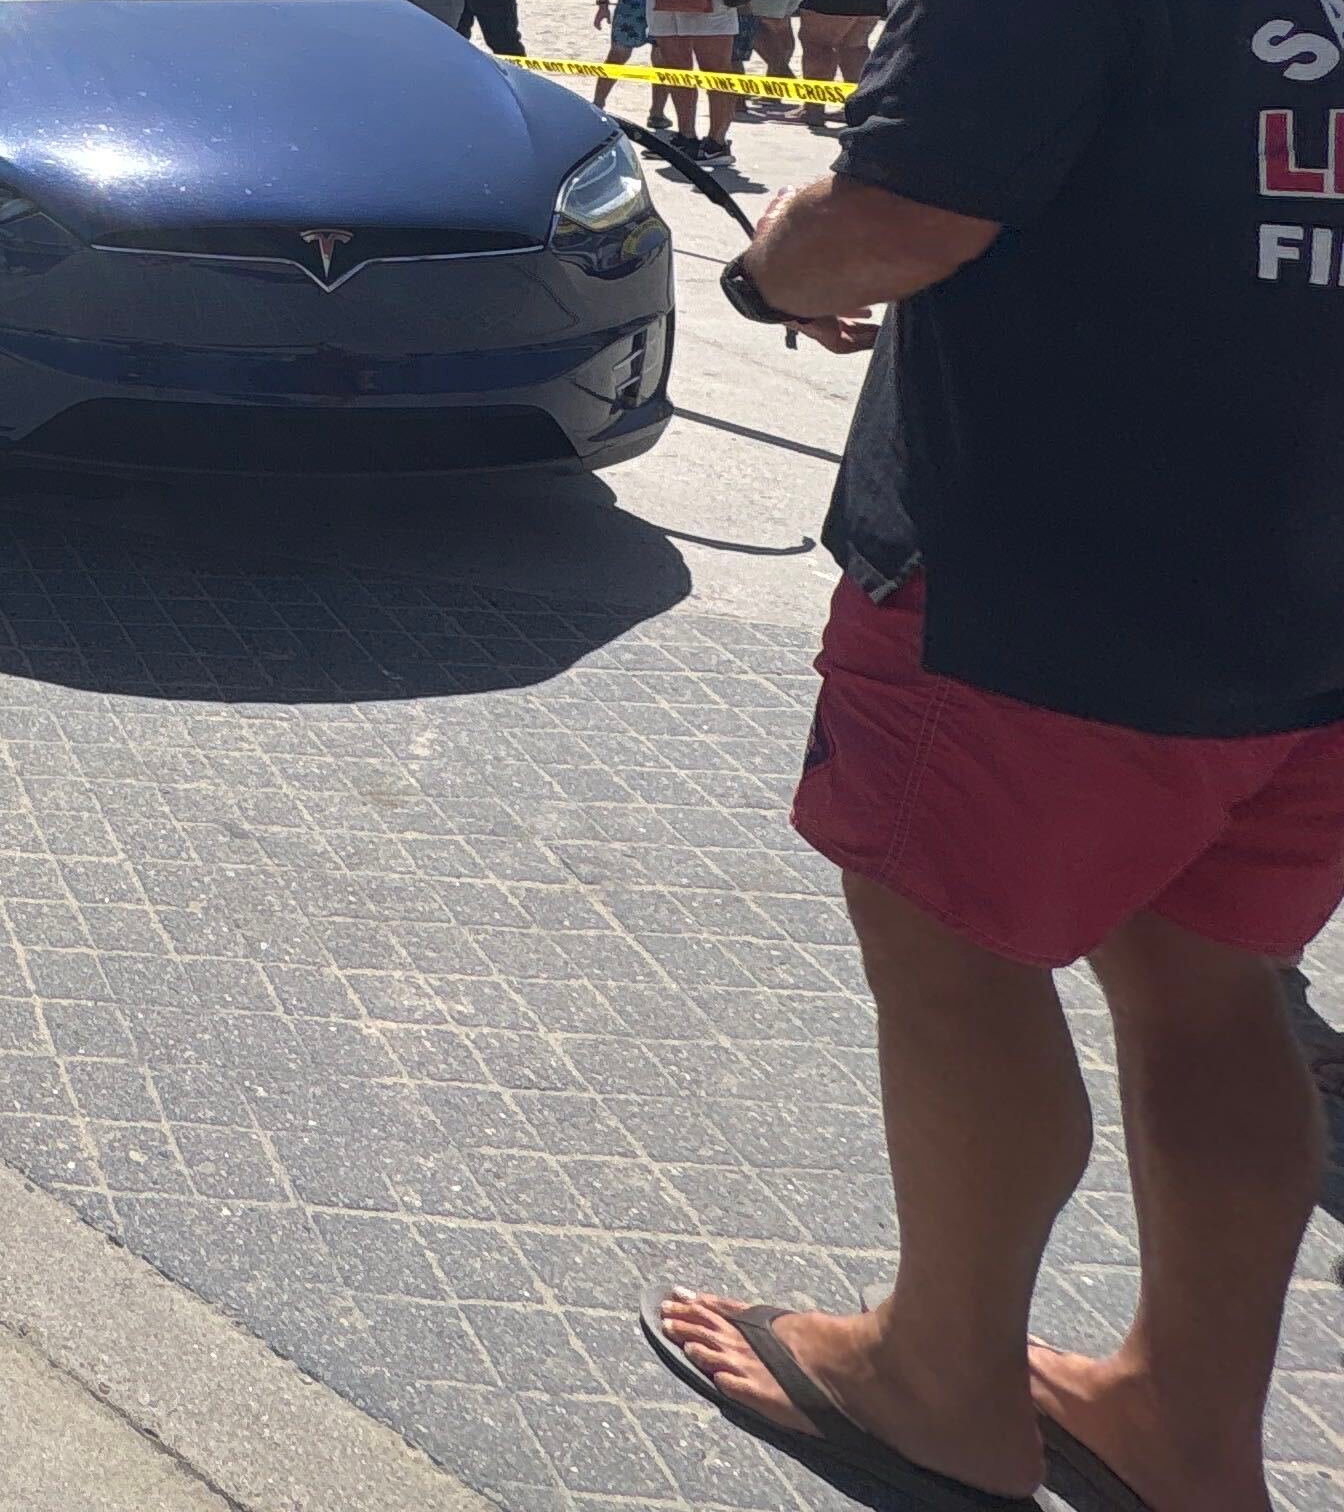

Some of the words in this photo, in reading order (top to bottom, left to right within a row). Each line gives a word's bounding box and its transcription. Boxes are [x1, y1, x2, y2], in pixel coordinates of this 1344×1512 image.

[542, 61, 567, 73] NOT
[567, 62, 609, 78] CROSS
[655, 71, 704, 89] POLICE
[706, 76, 740, 94] LINE
[739, 78, 760, 95] DO
[763, 79, 793, 99] NOT
[793, 82, 847, 104] CROSS
